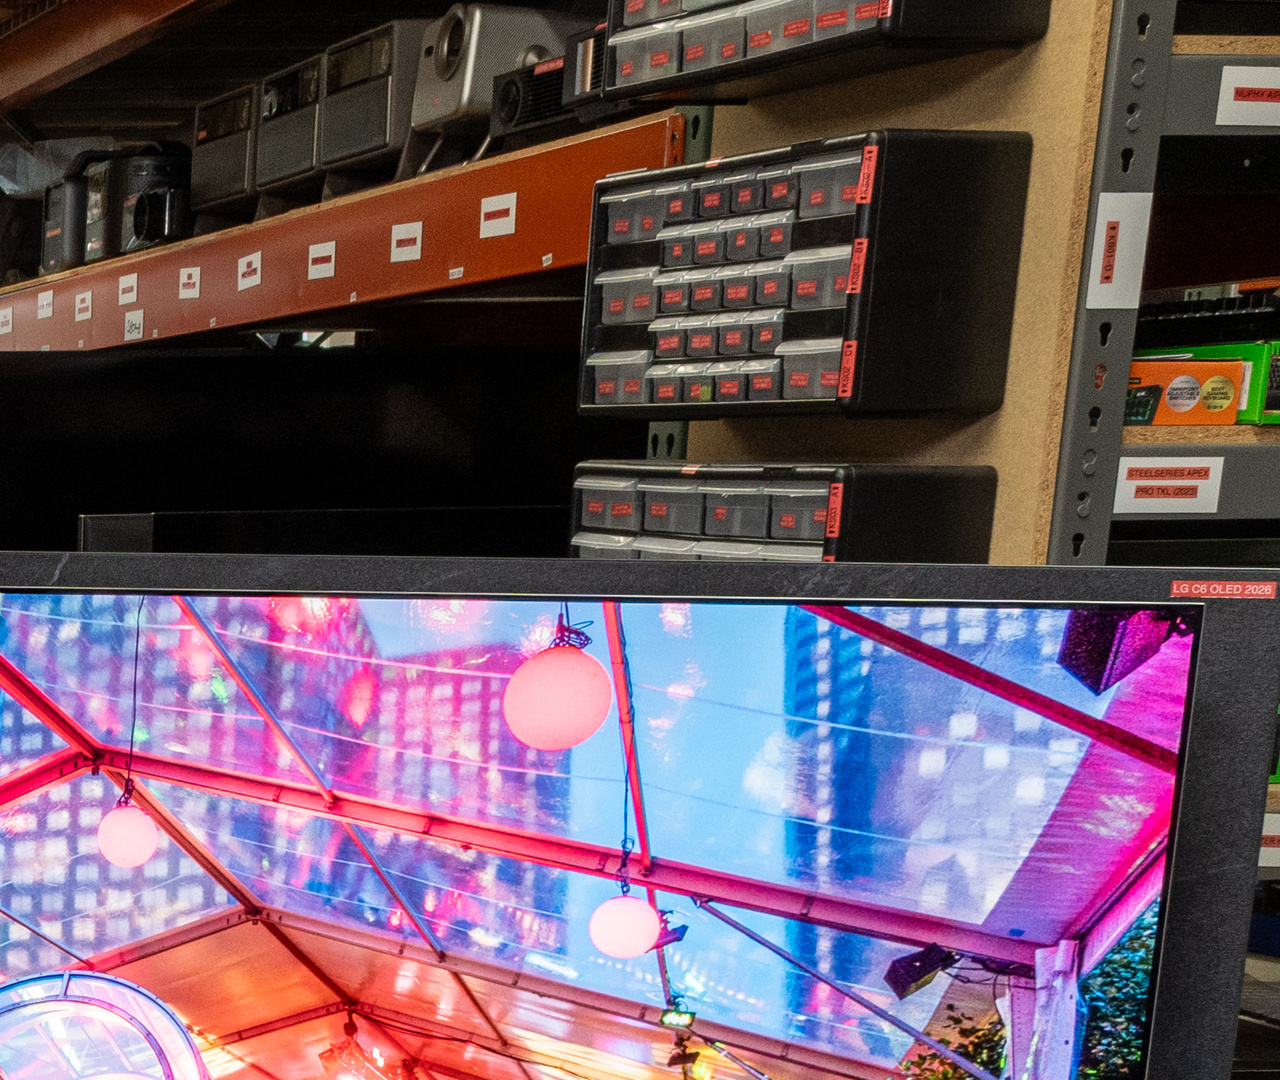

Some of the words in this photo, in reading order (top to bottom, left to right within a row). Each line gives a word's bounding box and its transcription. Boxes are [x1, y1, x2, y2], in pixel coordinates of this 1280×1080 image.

[1127, 469, 1185, 477] STEELSERIES
[1186, 469, 1209, 477] APEX
[1135, 487, 1154, 495] PRO
[1156, 487, 1171, 495] TKL
[1173, 584, 1189, 593] LG
[1191, 584, 1207, 593] C6
[1209, 584, 1242, 593] OLED
[1244, 585, 1272, 594] 2026
